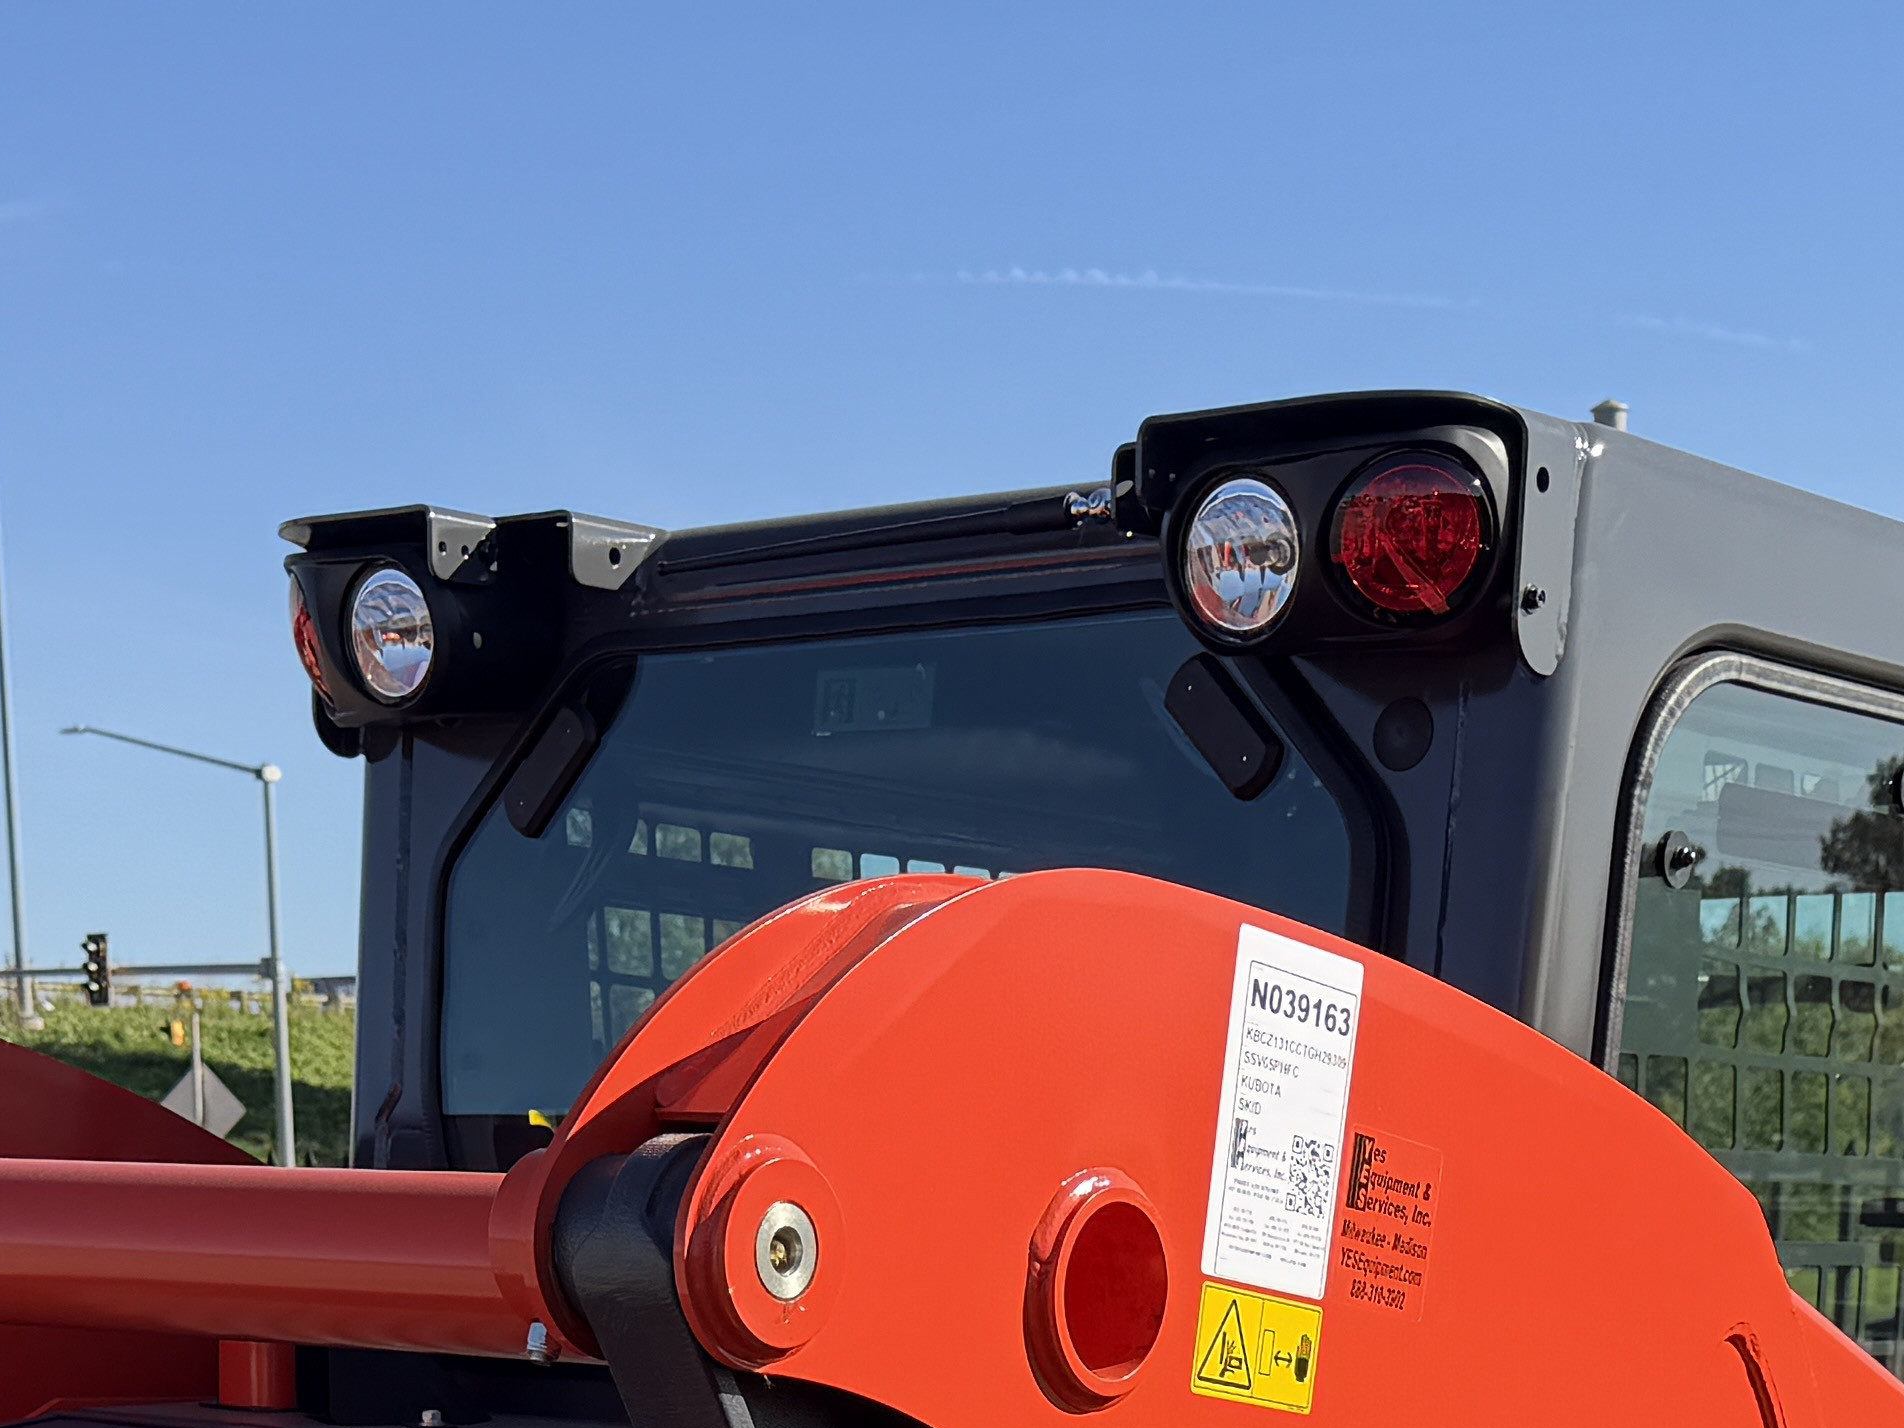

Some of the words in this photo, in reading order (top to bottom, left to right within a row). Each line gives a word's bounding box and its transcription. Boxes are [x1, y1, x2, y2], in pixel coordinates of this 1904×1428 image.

[1251, 978, 1351, 1036] N039163
[1240, 1073, 1282, 1098] KUBOTA
[1364, 1138, 1387, 1163] Yes
[1360, 1165, 1421, 1200] Equipment
[1422, 1182, 1432, 1201] &
[1357, 1189, 1409, 1226] Services,
[1411, 1204, 1432, 1228] Inc.
